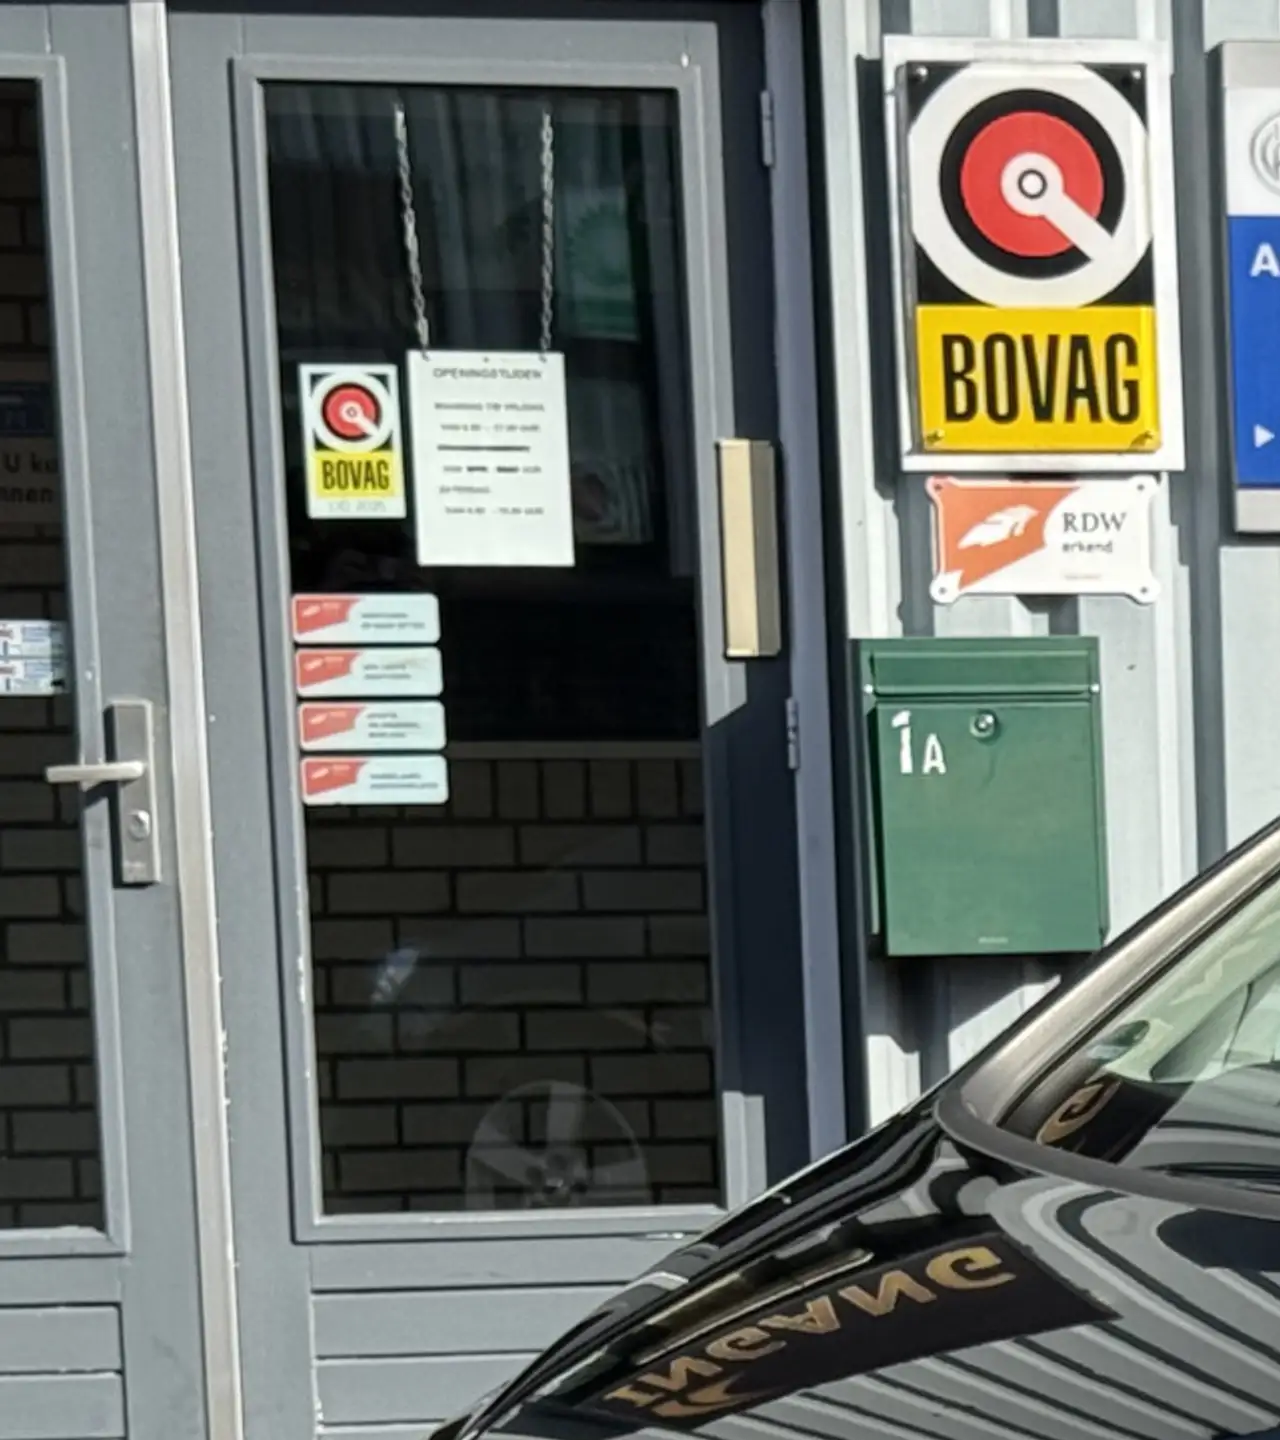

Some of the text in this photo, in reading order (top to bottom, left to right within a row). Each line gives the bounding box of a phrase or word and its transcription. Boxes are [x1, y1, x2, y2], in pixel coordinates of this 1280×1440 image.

[941, 333, 1140, 424] BOVAG
[321, 460, 390, 491] BOVAG
[1062, 512, 1126, 533] RDW
[1062, 541, 1113, 553] erkend
[891, 709, 947, 775] 1A
